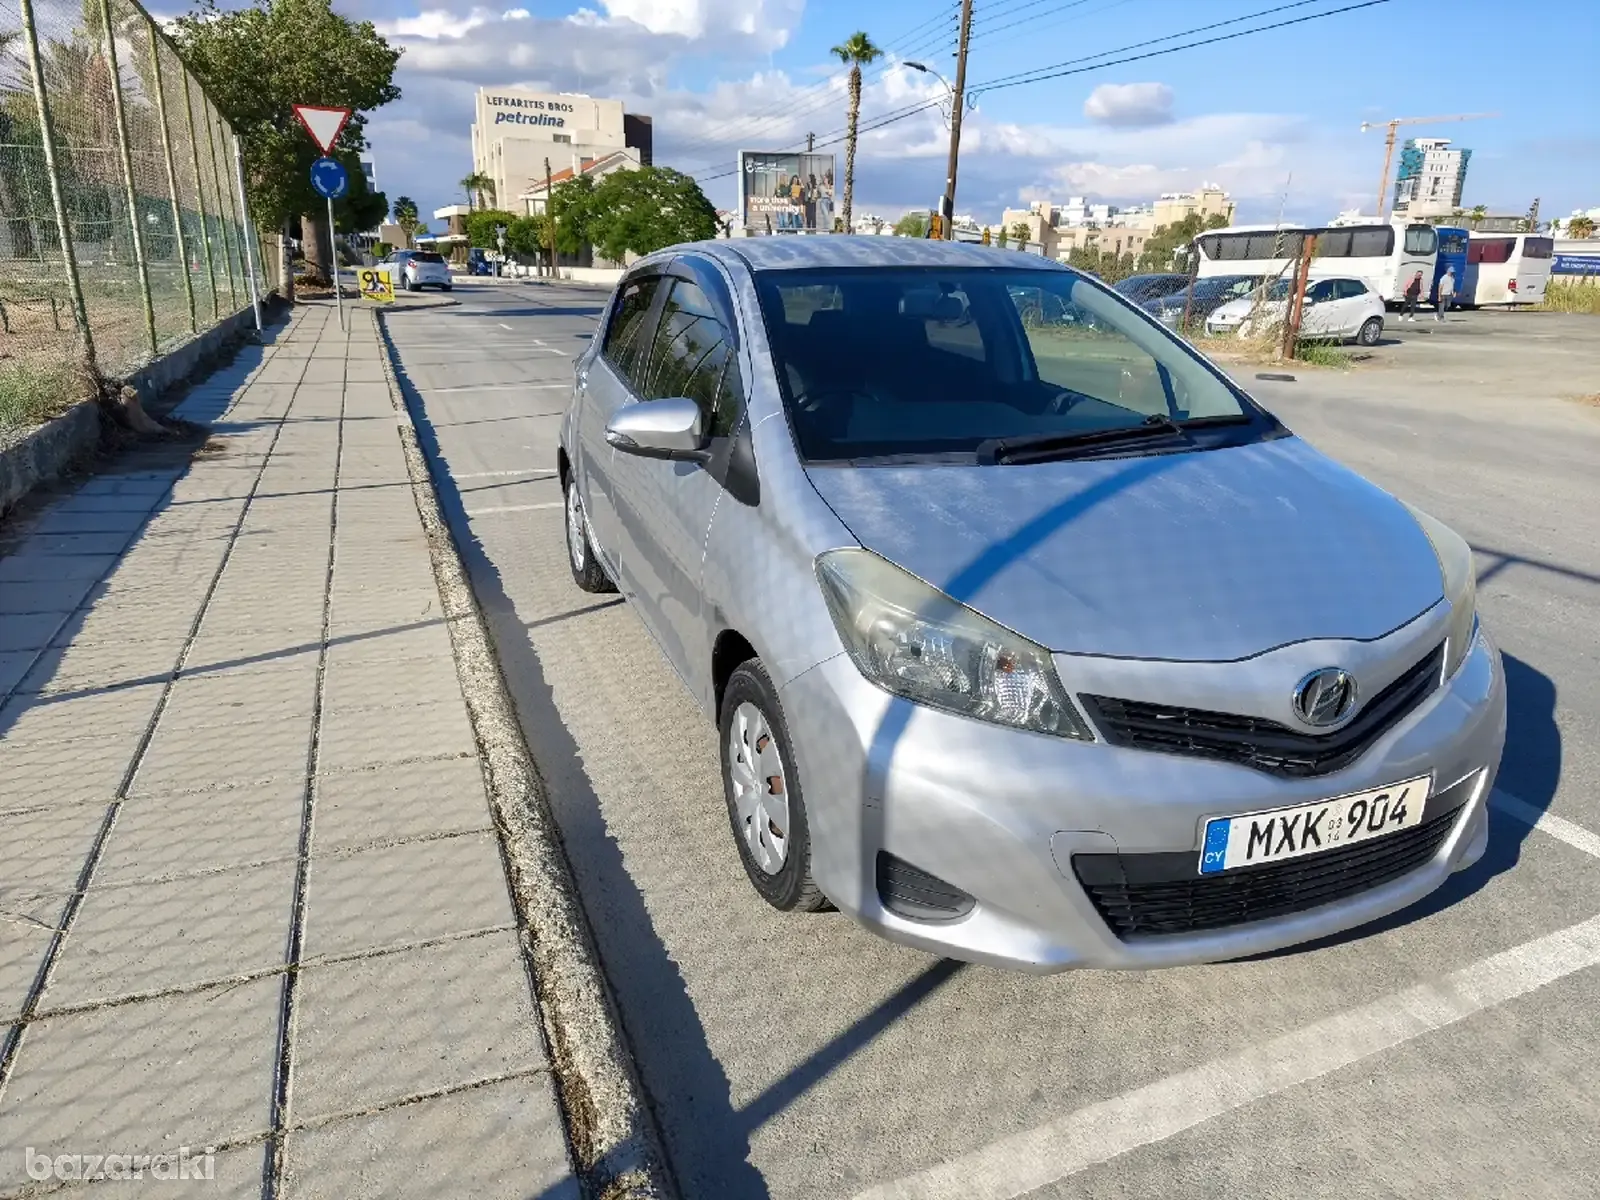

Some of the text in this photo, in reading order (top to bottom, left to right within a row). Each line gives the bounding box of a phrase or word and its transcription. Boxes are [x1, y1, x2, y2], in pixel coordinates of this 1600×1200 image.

[487, 96, 574, 112] LEFKARITIS BROS
[495, 111, 565, 128] petrolina
[1246, 787, 1410, 860] MXK 904
[1328, 817, 1343, 830] 03
[1205, 852, 1222, 864] CY
